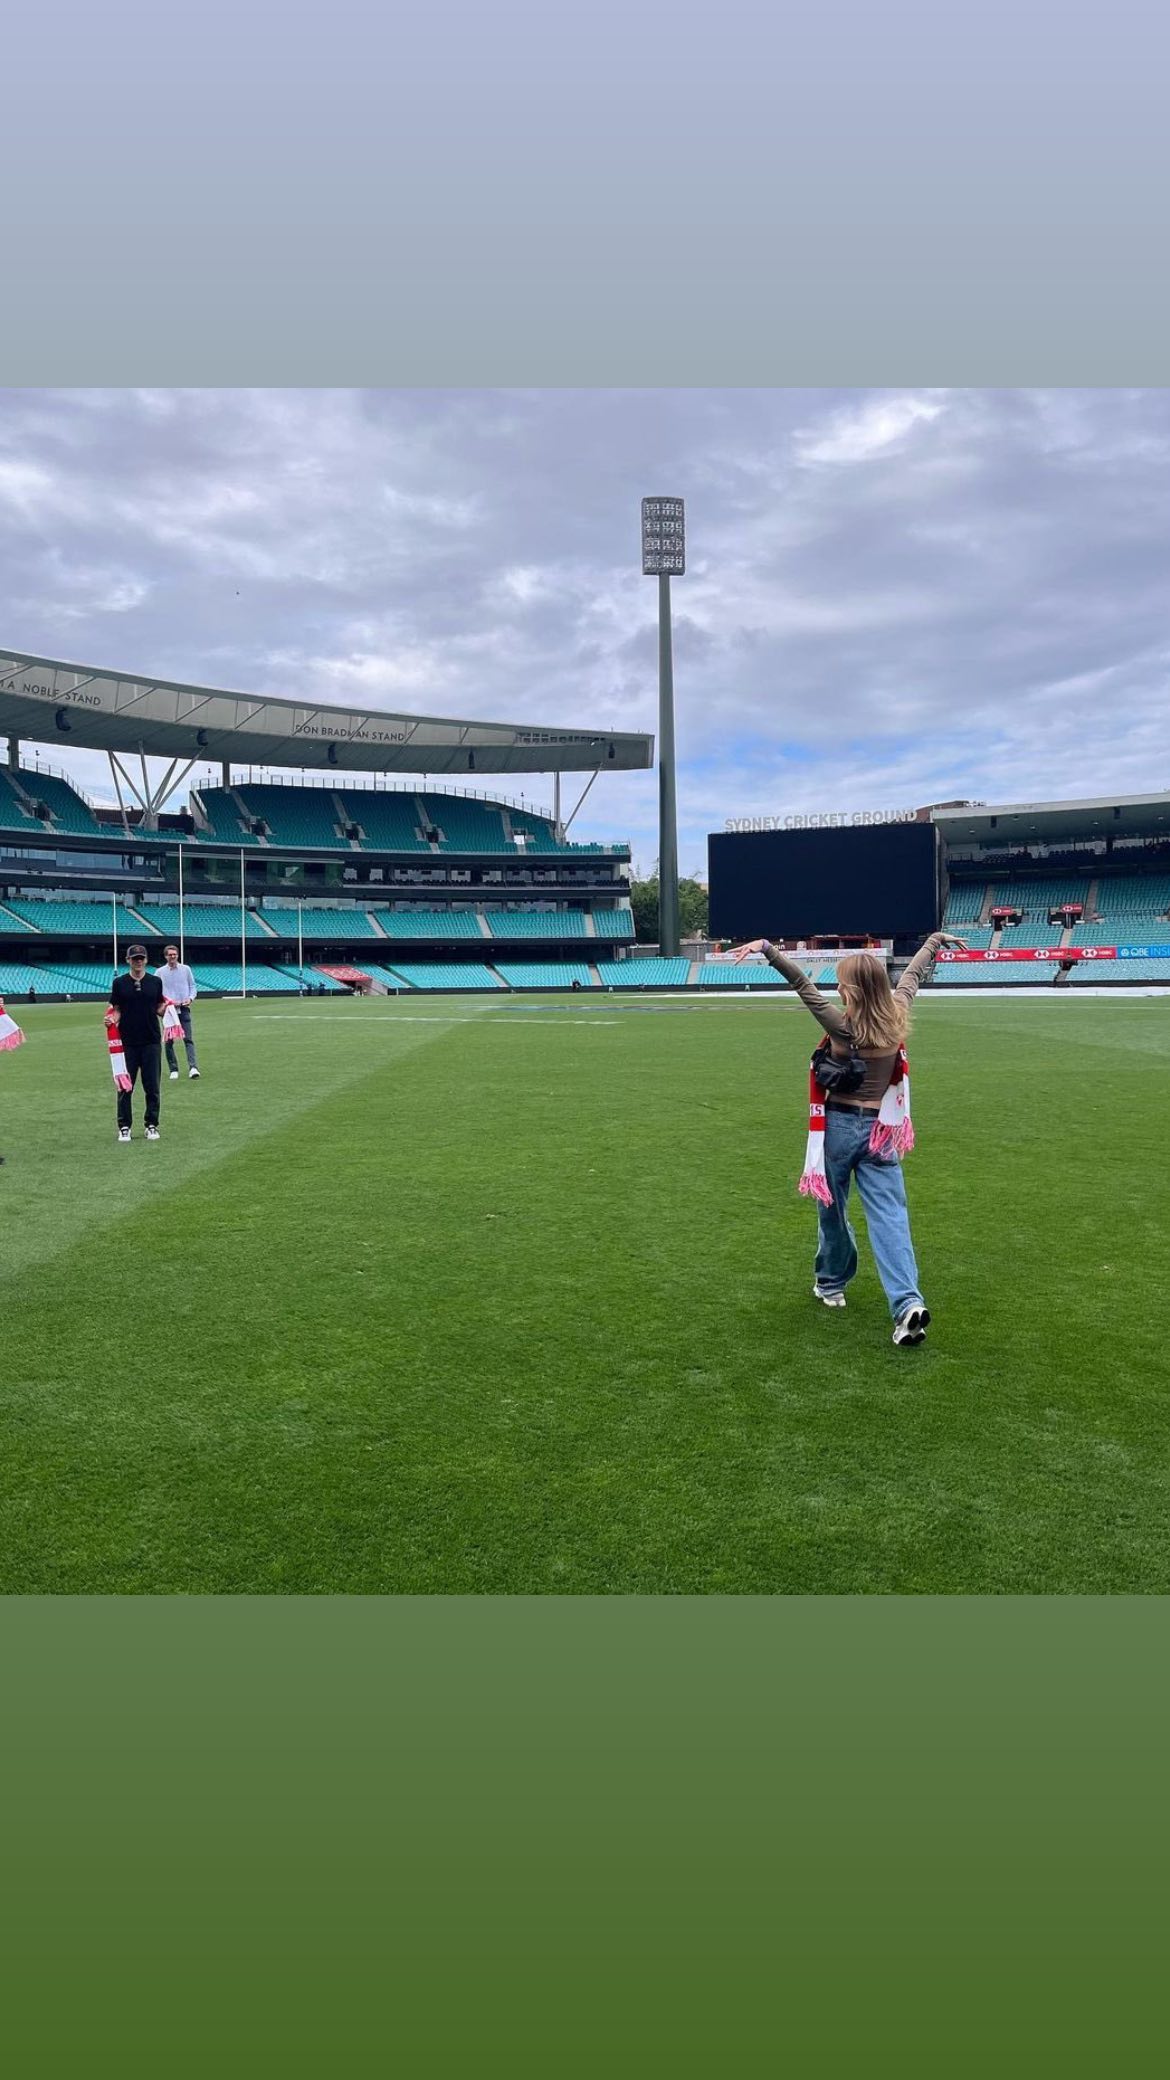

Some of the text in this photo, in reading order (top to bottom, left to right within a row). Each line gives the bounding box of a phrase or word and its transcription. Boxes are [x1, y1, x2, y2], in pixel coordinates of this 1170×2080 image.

[23, 683, 60, 697] NOBLE
[65, 692, 101, 706] STAND
[295, 724, 318, 735] DON
[371, 731, 405, 741] STAND
[725, 808, 918, 832] SYDNEY CRICKET GROUND
[1131, 947, 1149, 956] QBE
